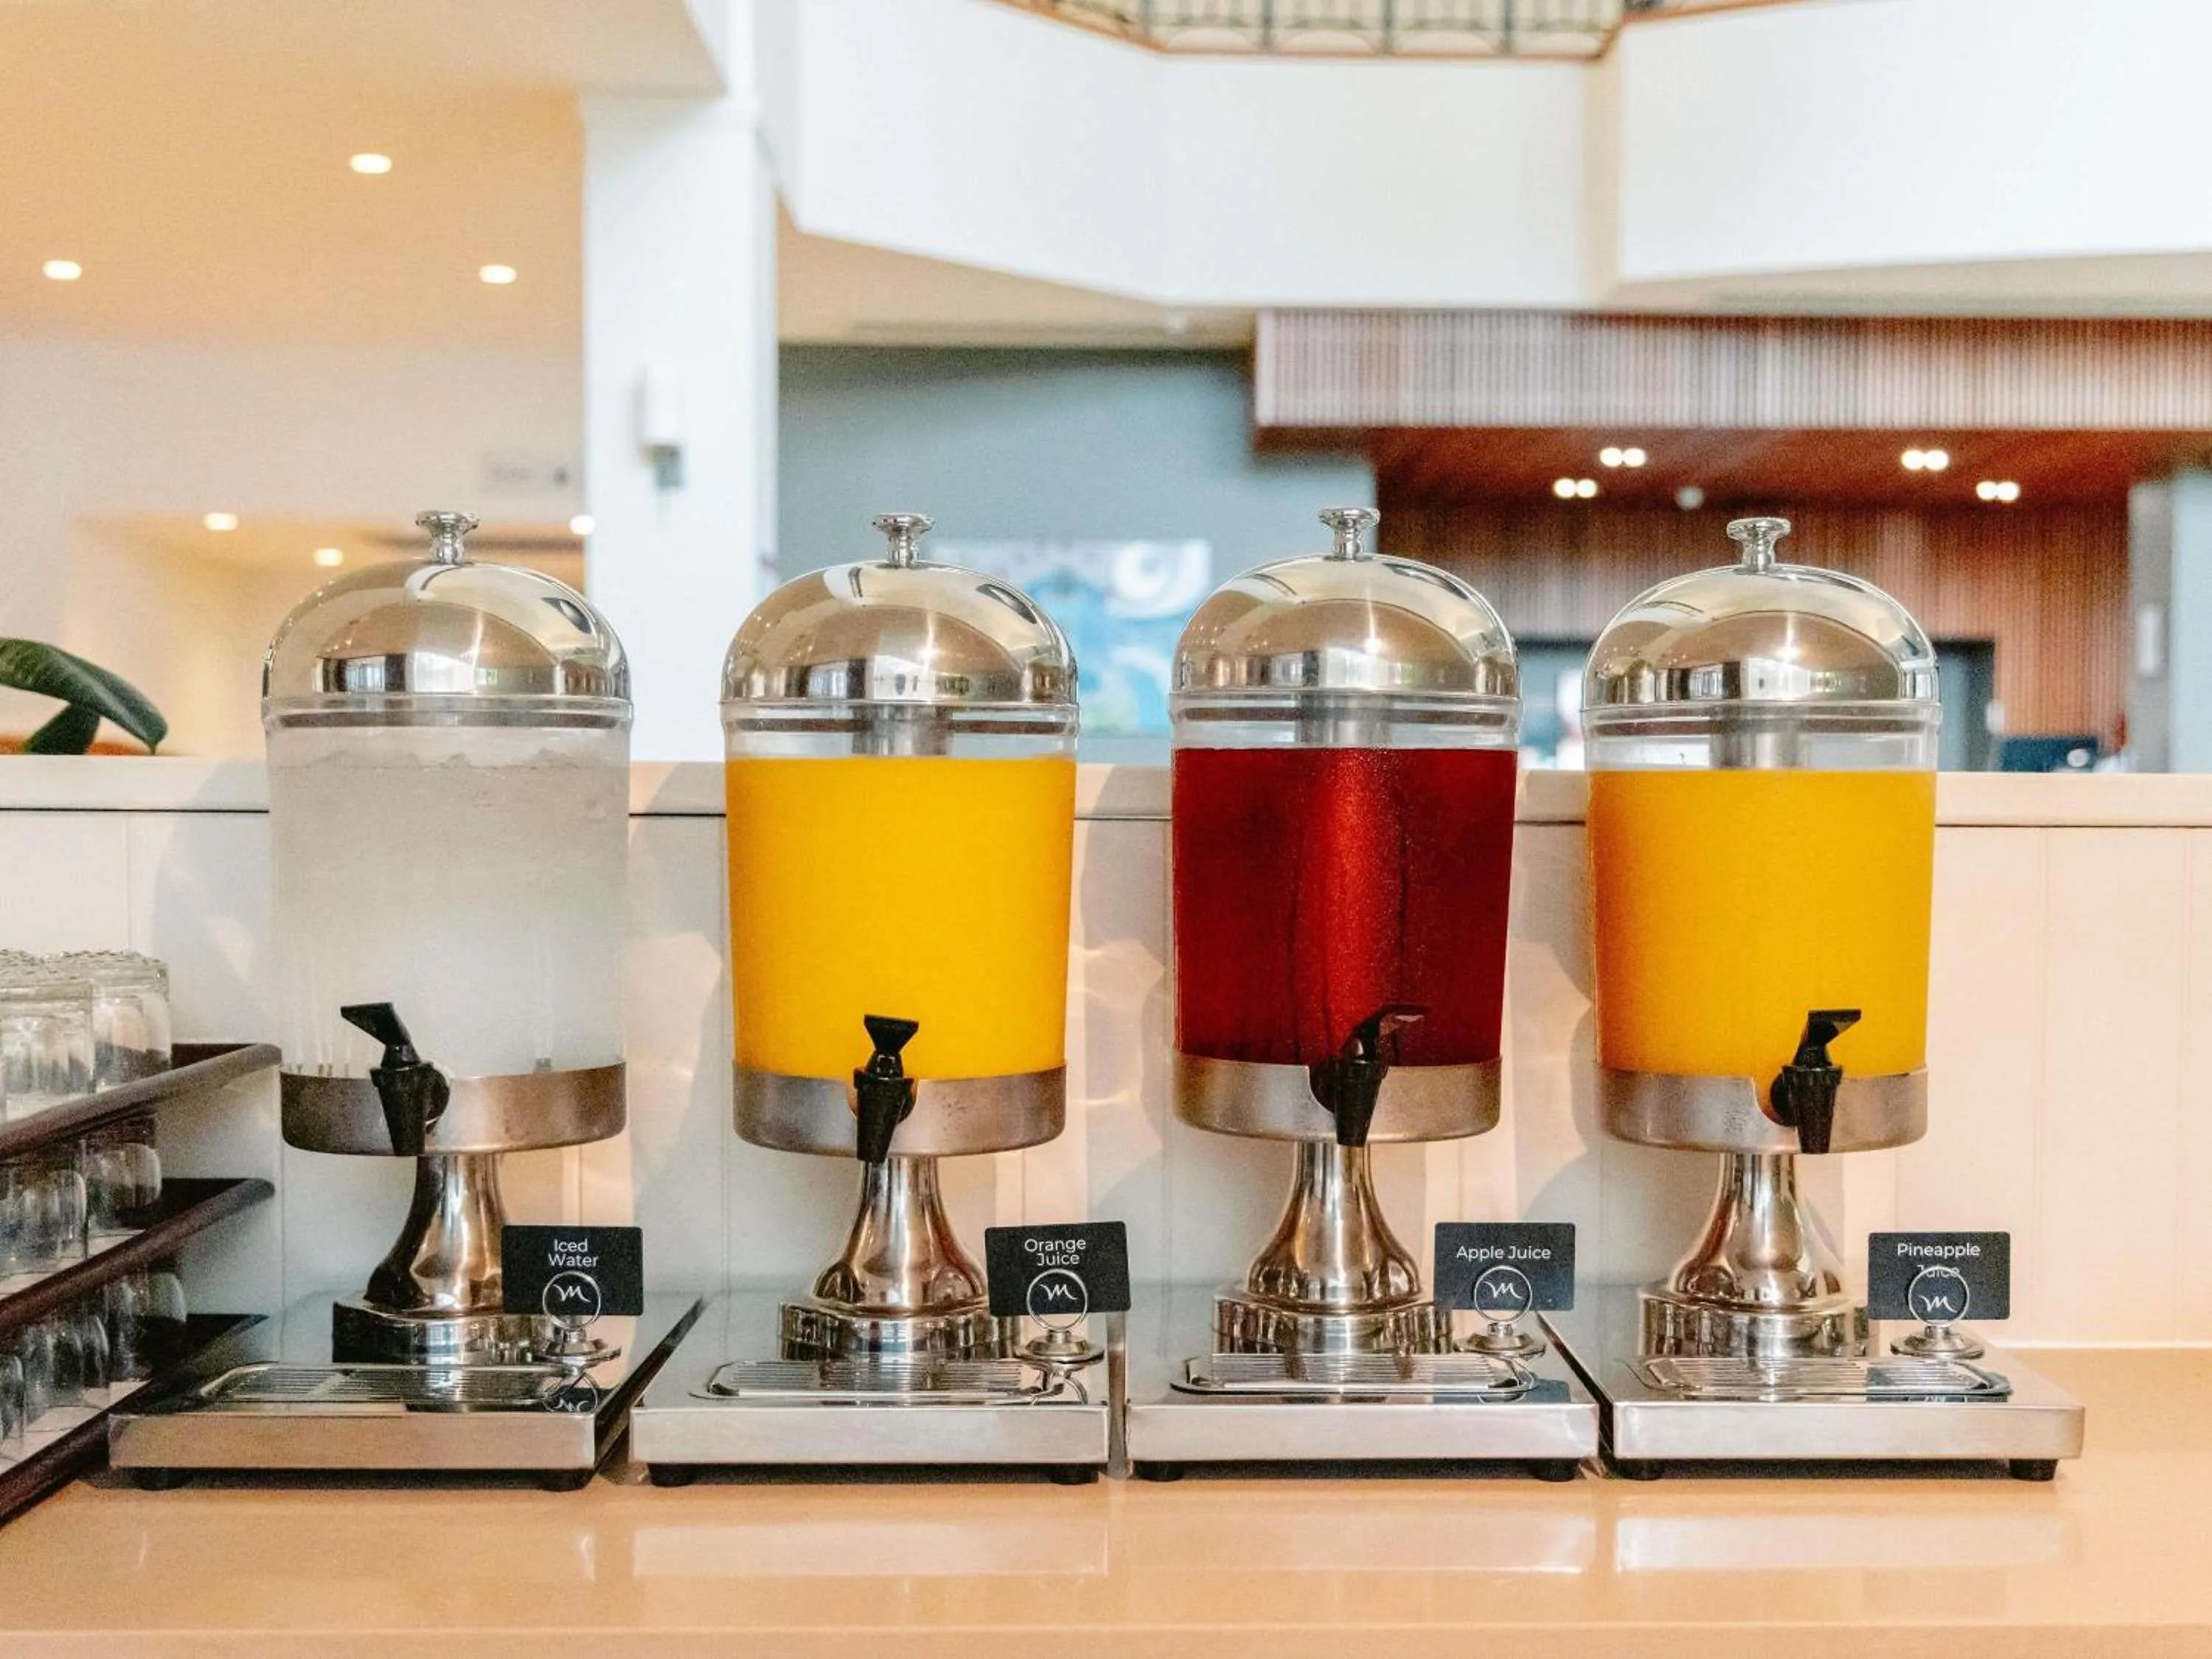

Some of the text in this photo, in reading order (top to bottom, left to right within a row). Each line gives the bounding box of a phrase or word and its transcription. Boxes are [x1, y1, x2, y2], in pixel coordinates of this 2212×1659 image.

[554, 1239, 589, 1253] Iced
[1024, 1238, 1087, 1253] Orange
[1897, 1242, 1981, 1259] Pineapple
[548, 1253, 599, 1267] Water
[1037, 1252, 1080, 1267] Juice
[1455, 1245, 1552, 1262] Apple Juice
